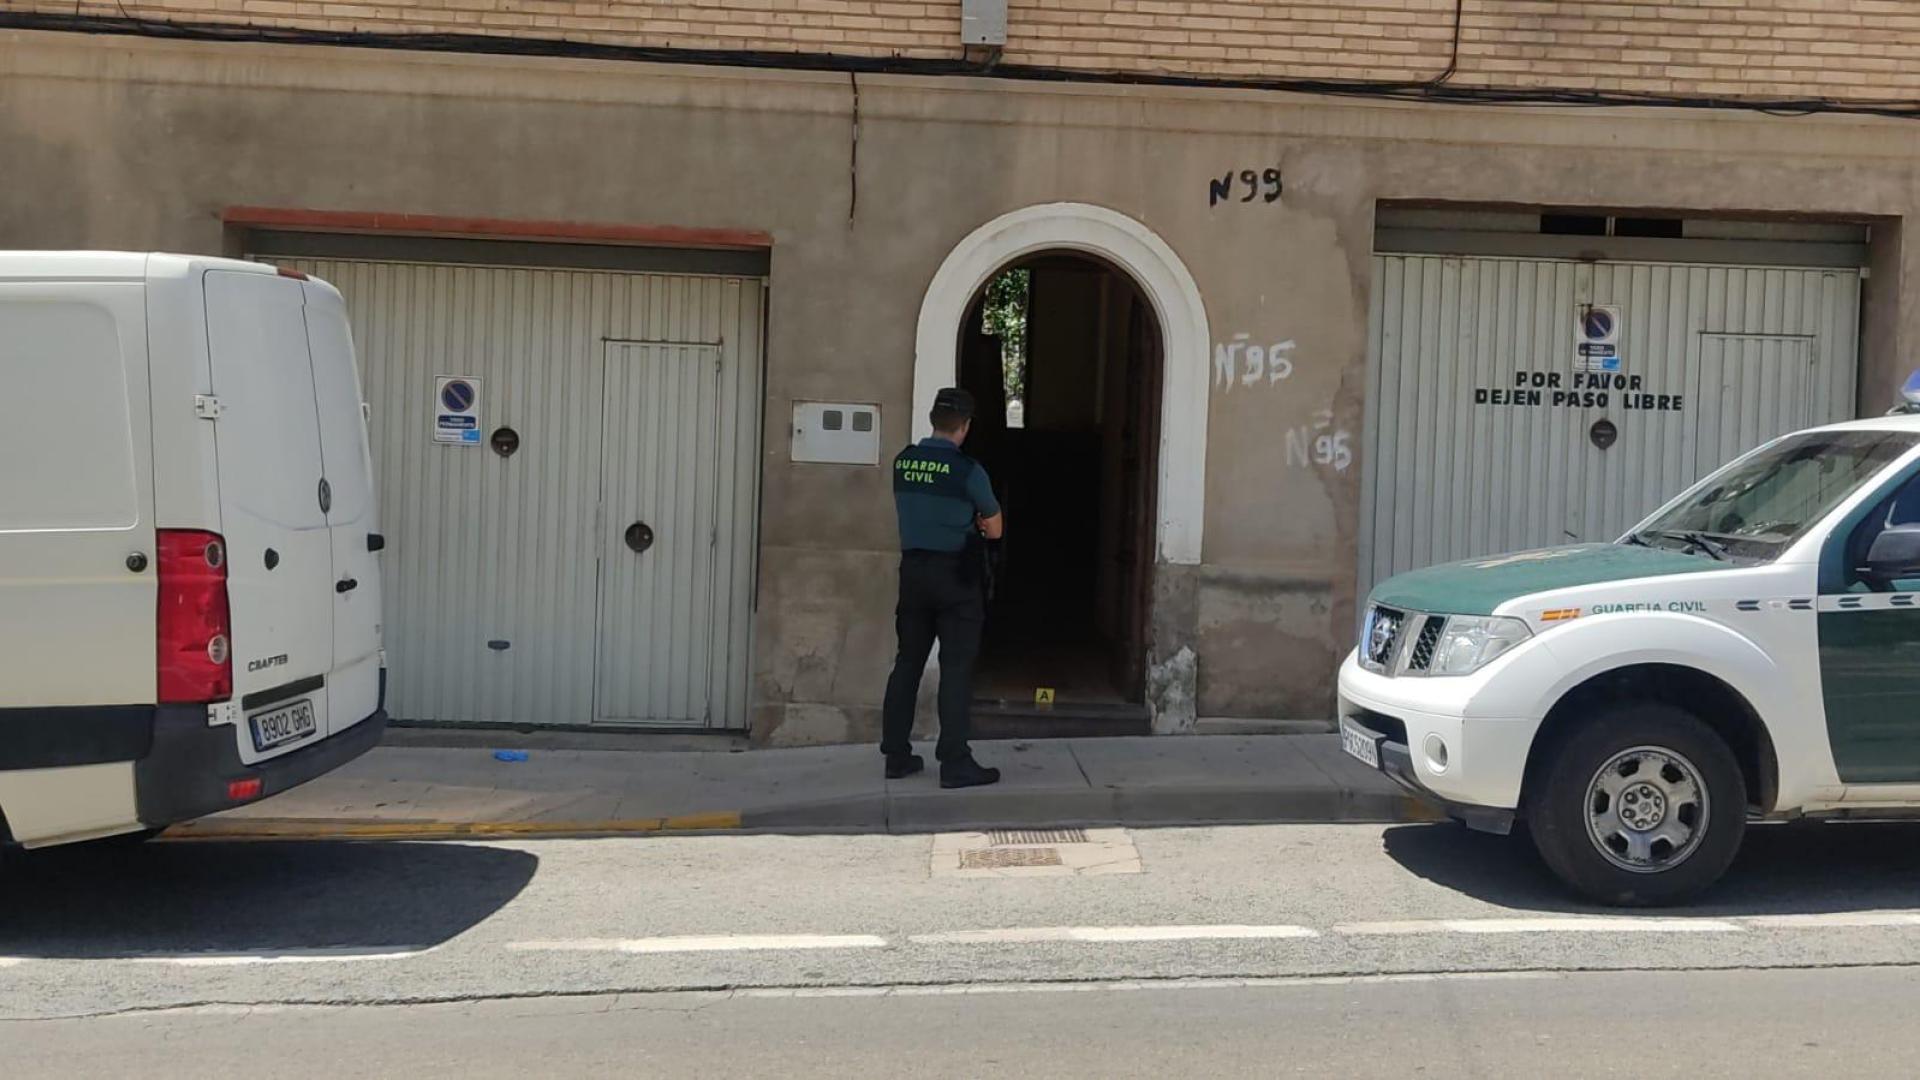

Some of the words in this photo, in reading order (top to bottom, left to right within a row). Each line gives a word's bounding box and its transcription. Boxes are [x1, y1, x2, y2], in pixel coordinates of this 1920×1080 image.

[1515, 371, 1561, 388] POR
[1573, 373, 1642, 390] FAVOR
[1475, 389, 1541, 406] DEJEN
[1552, 391, 1609, 408] PASO
[1623, 393, 1683, 411] LIBRE
[895, 459, 950, 474] GUARDIA
[904, 471, 934, 484] CIVIL
[1668, 601, 1707, 613] CIVIL
[1040, 690, 1049, 701] A
[261, 712, 291, 741] 8902
[291, 705, 311, 731] GHG
